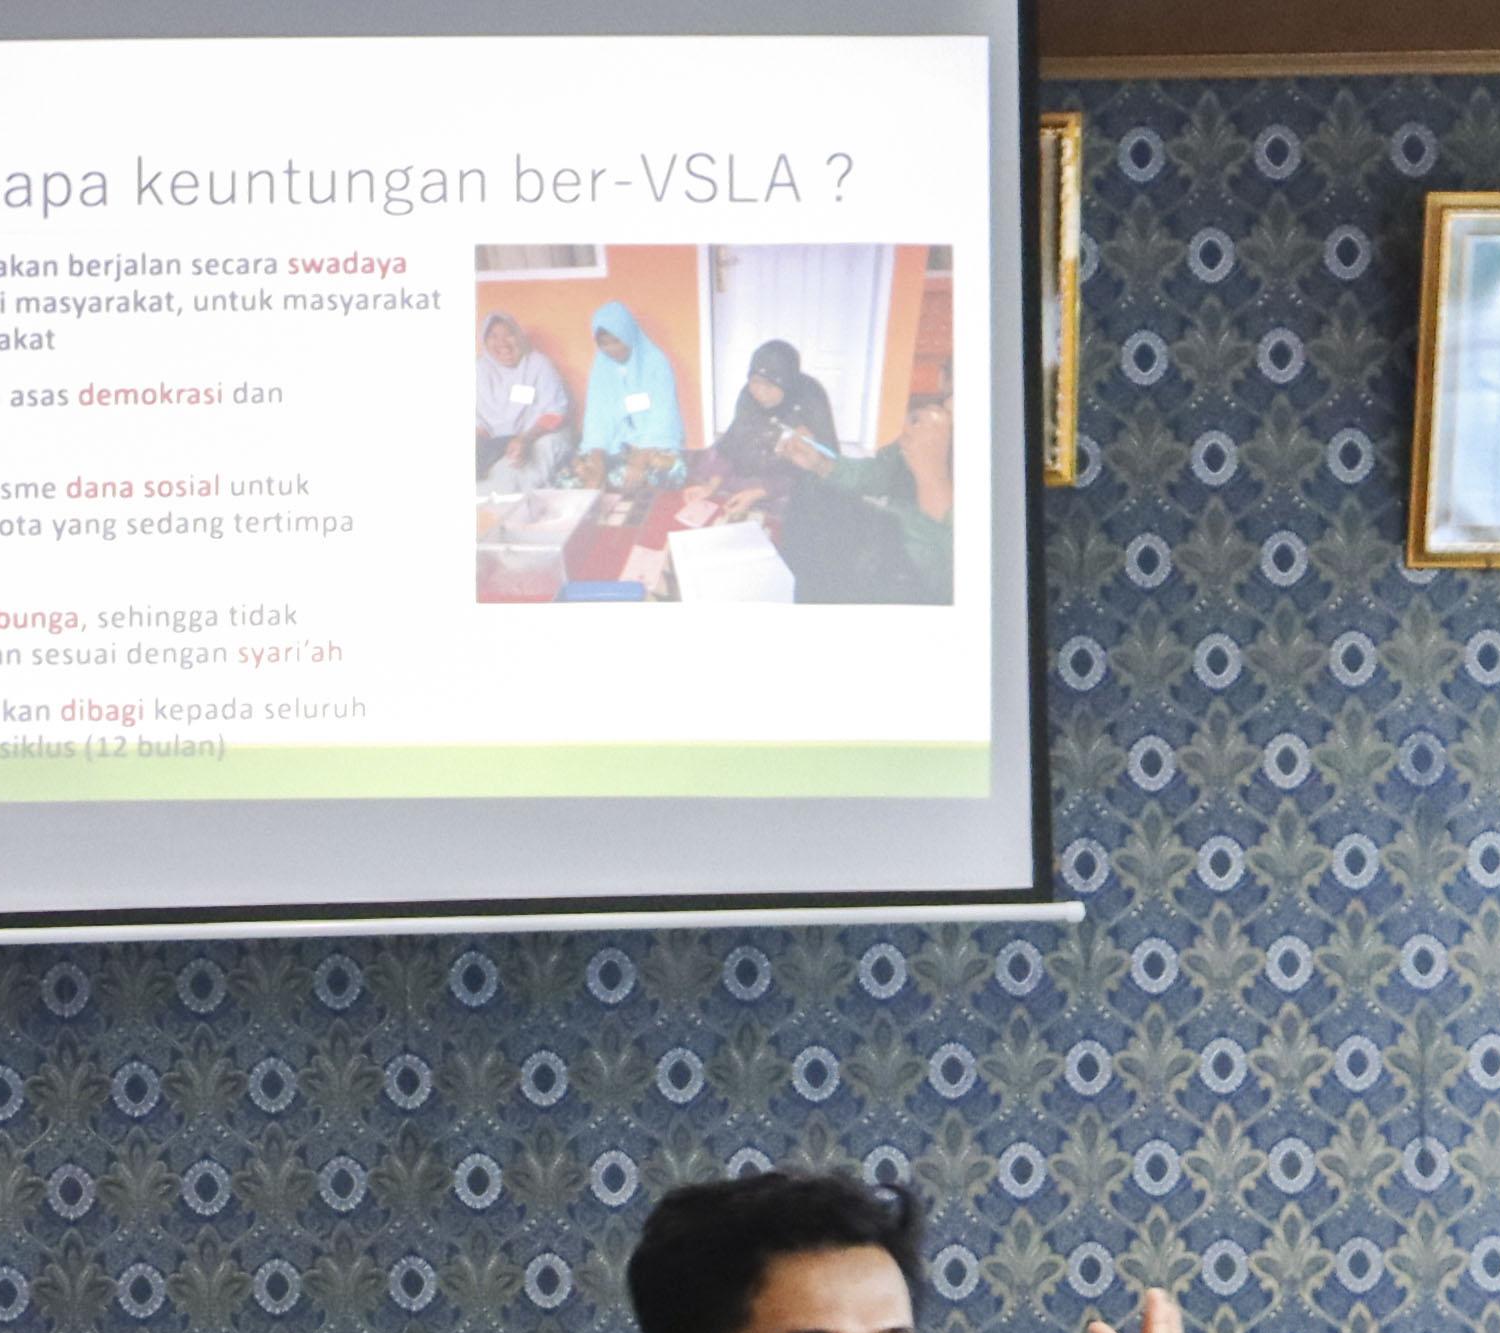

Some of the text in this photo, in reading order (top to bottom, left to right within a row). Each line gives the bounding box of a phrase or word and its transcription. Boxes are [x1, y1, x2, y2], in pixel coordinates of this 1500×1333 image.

[4, 171, 107, 219] apa
[137, 156, 485, 216] keuntungan
[516, 152, 801, 203] ber-VSLA
[826, 152, 853, 202] ?
[69, 253, 181, 282] berjalan
[192, 257, 277, 276] secara
[288, 251, 407, 280] swadaya
[16, 289, 182, 319] masyarakat,
[194, 288, 272, 312] untuk
[283, 287, 440, 316] masyarakat
[10, 389, 69, 407] asas
[78, 382, 222, 406] demokrasi
[233, 381, 283, 404] dan
[66, 476, 134, 499] dana
[144, 474, 219, 498] sosial
[230, 473, 309, 497] untuk
[52, 518, 116, 541] yang
[127, 511, 224, 539] sedang
[234, 513, 353, 538] tertimpa
[98, 605, 218, 633] sehingga
[229, 604, 297, 627] tidak
[32, 643, 116, 666] sesuai
[127, 642, 227, 670] dengan
[61, 698, 144, 727] dibagi
[154, 697, 253, 725] kepada
[264, 697, 366, 720] seluruh
[85, 734, 128, 762] (12
[136, 734, 226, 762] bulan)
